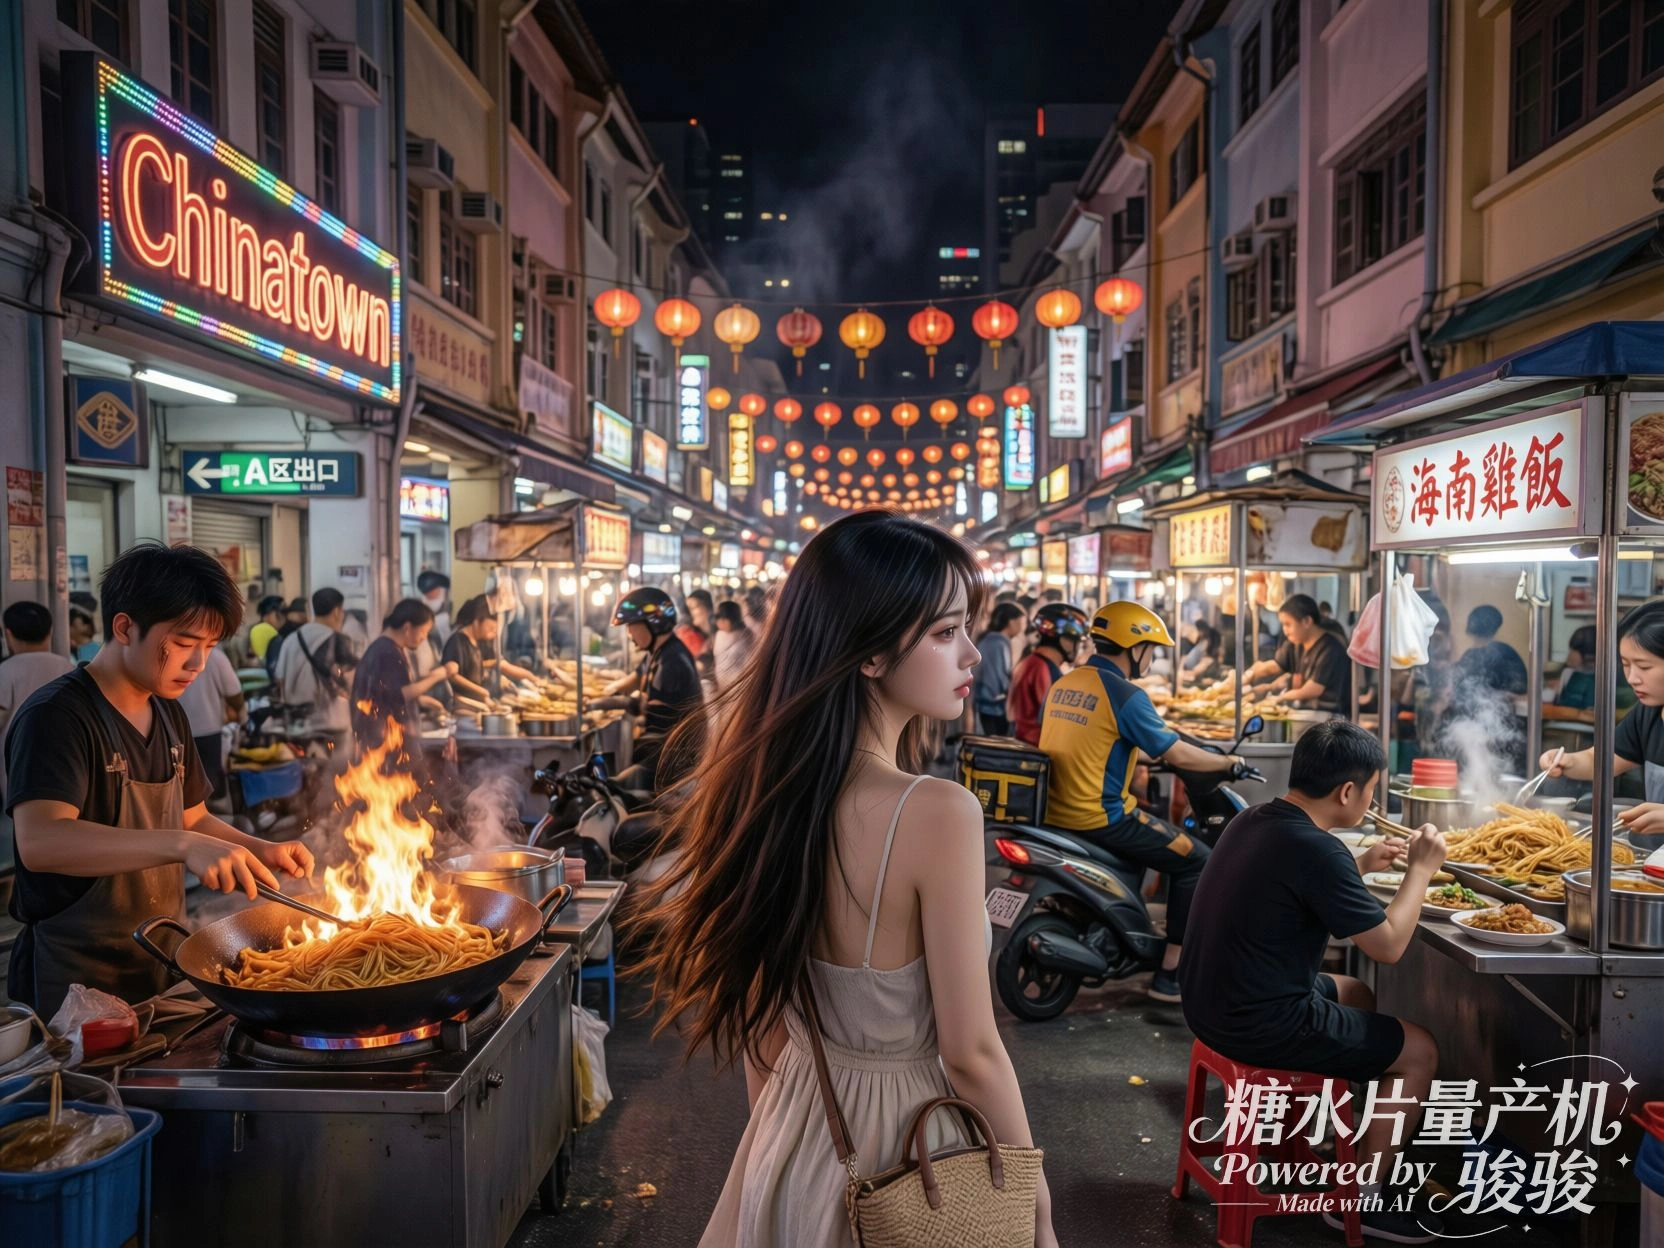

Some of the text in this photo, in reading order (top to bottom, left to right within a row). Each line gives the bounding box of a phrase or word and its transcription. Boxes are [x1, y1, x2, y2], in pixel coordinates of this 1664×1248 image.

[122, 133, 390, 367] Chinatown
[243, 457, 339, 485] A区出口
[1410, 432, 1571, 527] 海南雞飯
